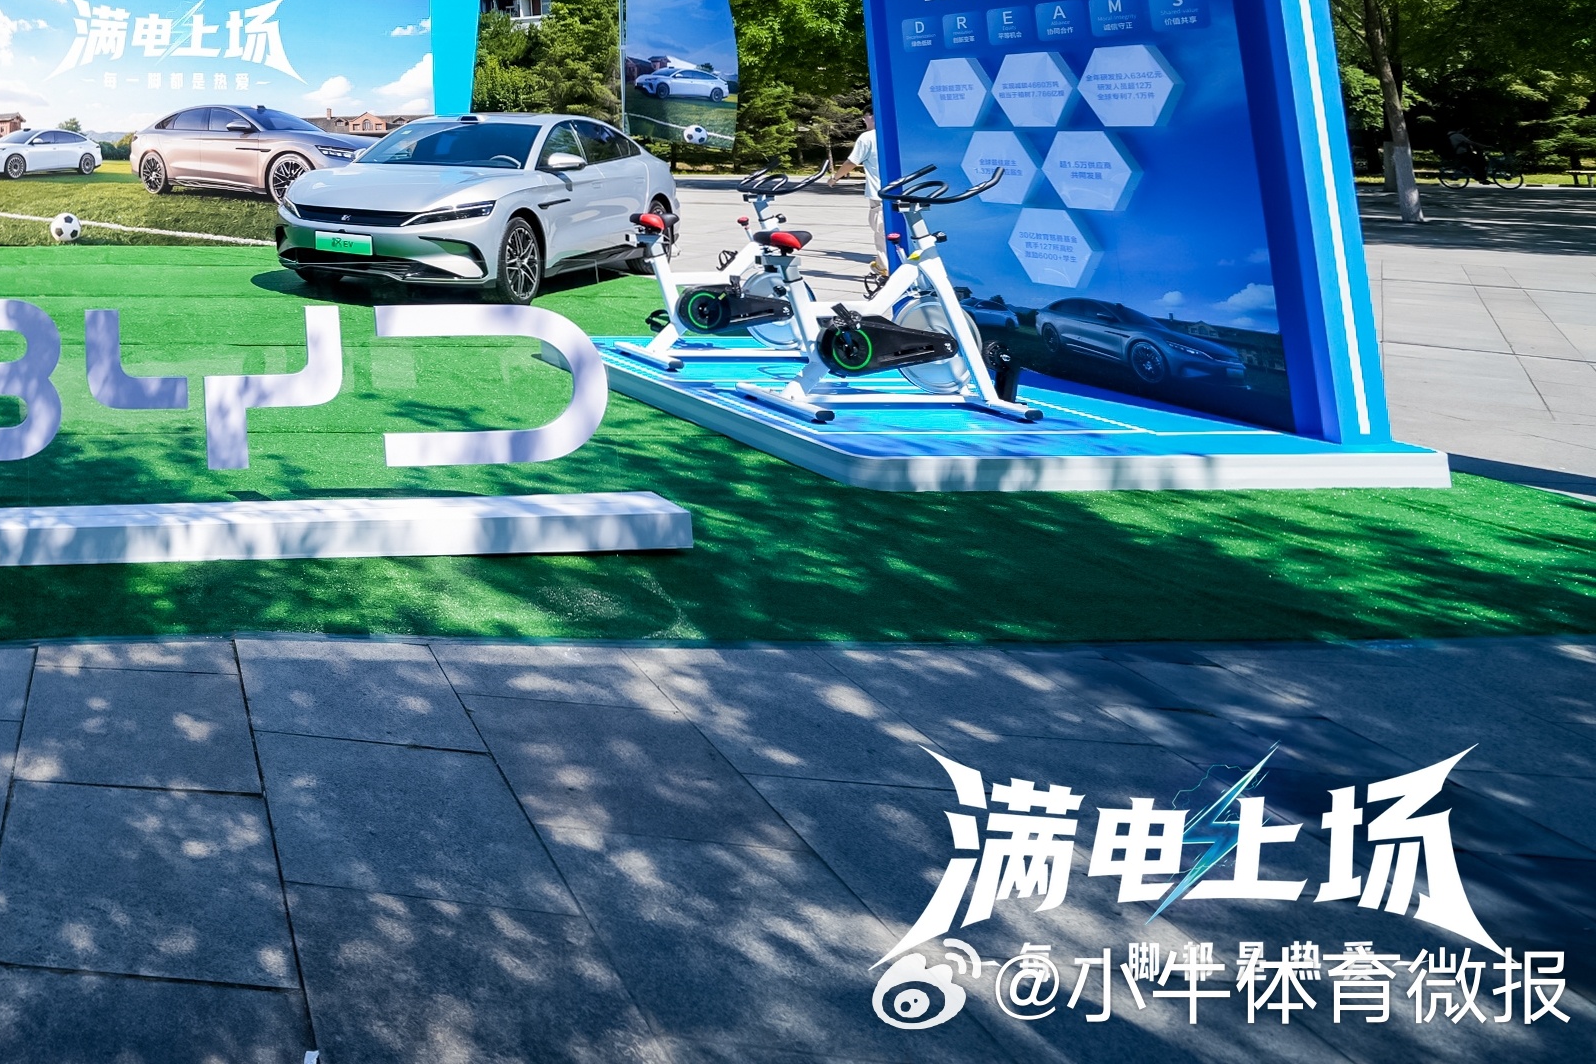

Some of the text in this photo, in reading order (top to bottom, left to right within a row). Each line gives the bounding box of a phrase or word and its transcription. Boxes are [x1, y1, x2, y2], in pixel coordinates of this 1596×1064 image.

[1053, 5, 1066, 19] A
[1108, 0, 1122, 13] M
[956, 16, 967, 29] R
[1002, 11, 1013, 25] E
[1164, 15, 1197, 26] 价值共享
[915, 21, 925, 34] D
[103, 72, 250, 91] 每一脚都是热爱
